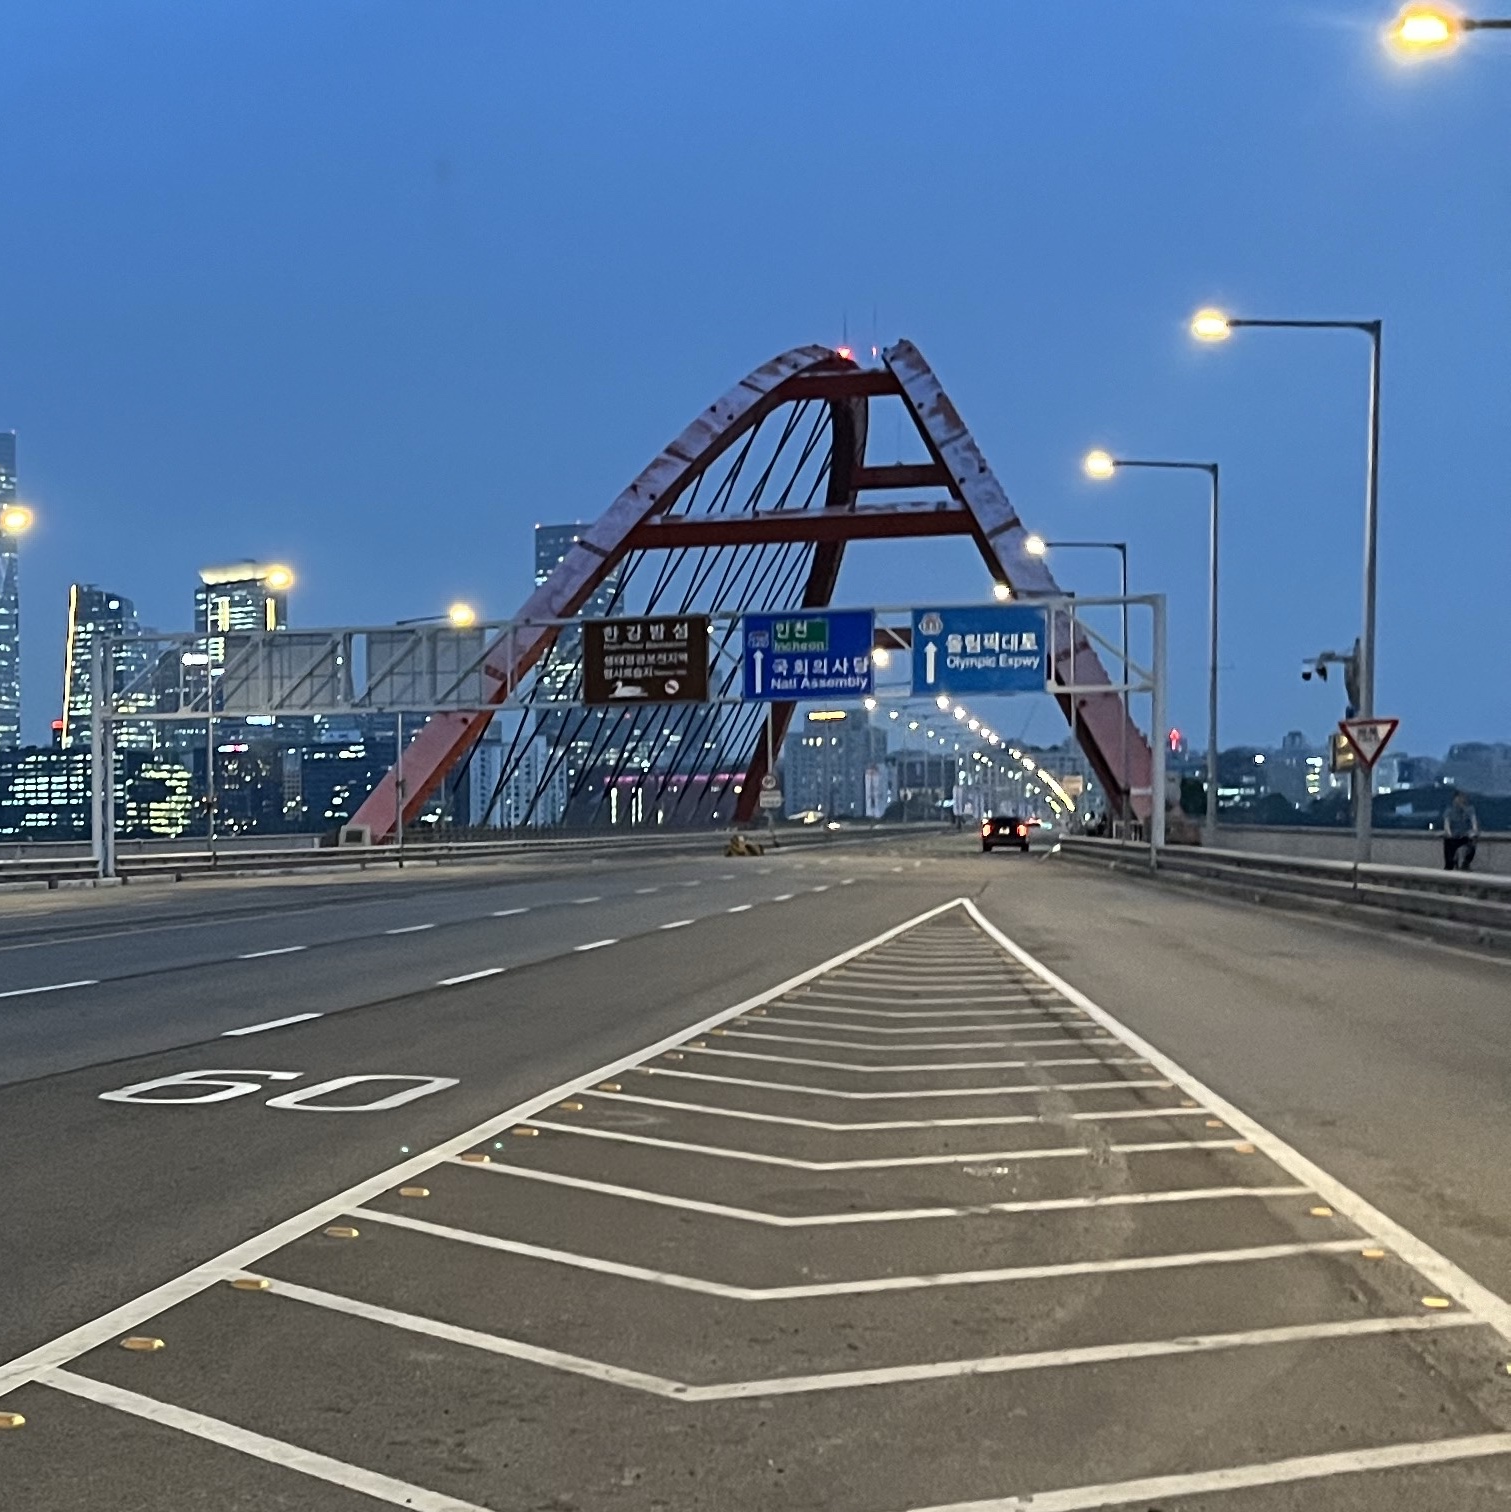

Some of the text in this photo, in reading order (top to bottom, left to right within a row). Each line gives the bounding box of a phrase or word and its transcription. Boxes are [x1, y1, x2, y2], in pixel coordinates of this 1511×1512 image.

[775, 620, 808, 639] 인천
[774, 641, 825, 652] Incheon
[946, 632, 1038, 653] 올림픽대로
[772, 657, 869, 676] 국회의사당
[946, 653, 1040, 670] Olympic Expwy
[800, 675, 868, 691] Assembly
[98, 1069, 461, 1112] 60
